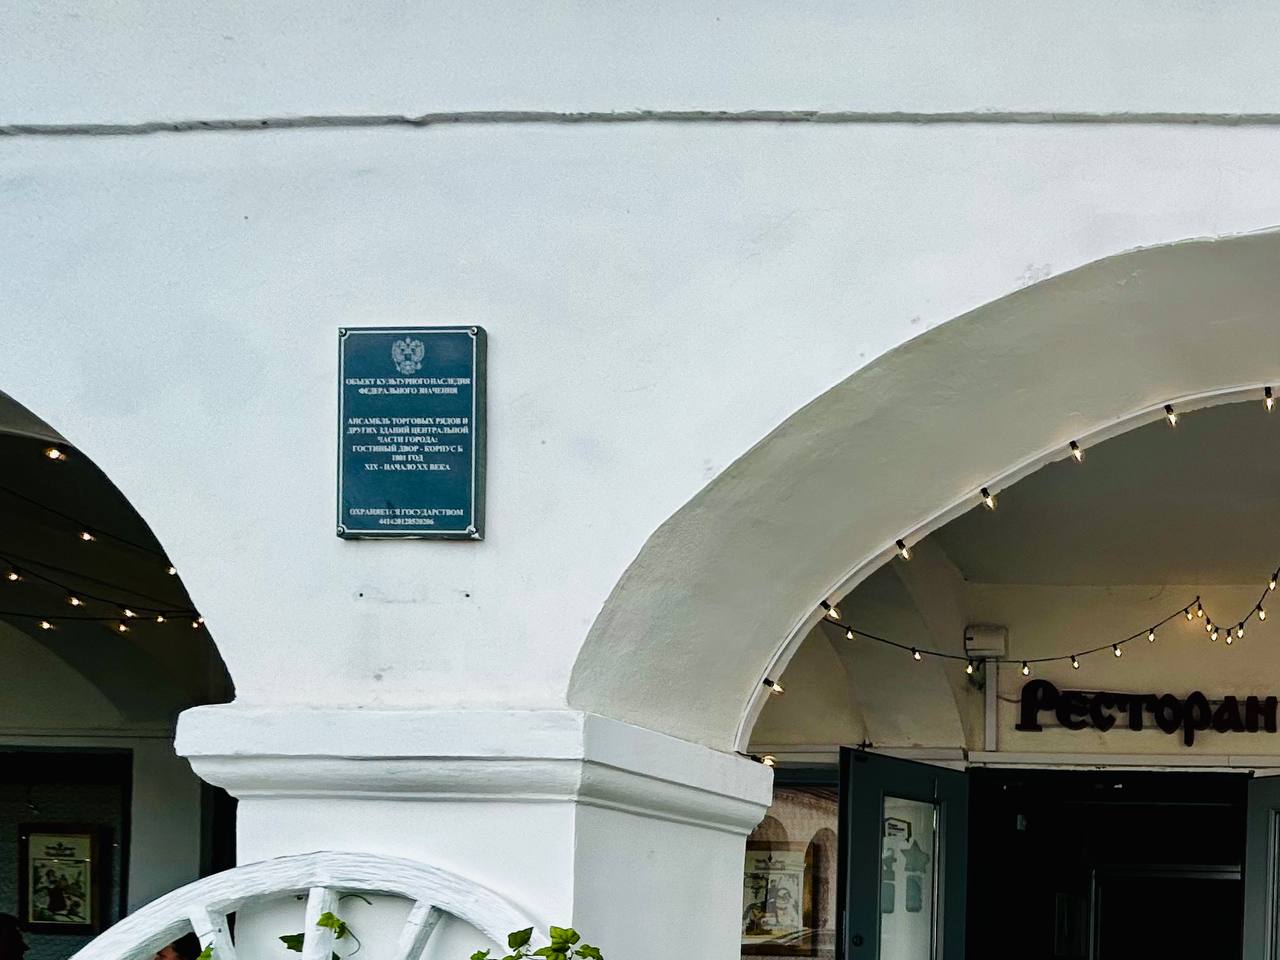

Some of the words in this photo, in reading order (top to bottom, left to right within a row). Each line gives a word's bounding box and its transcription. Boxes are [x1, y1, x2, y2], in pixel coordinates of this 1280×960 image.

[347, 417, 391, 425] АНСАМБЛЬ
[391, 417, 434, 425] ТОРГОВЫХ
[435, 417, 461, 425] РЯДОВ
[379, 426, 410, 434] ЗДАНИЙ
[410, 426, 469, 434] ЦЕНТРАЛЬНОЙ
[401, 508, 464, 516] ГОСУДАРСТВОМ
[1014, 678, 1278, 747] Ресторан
